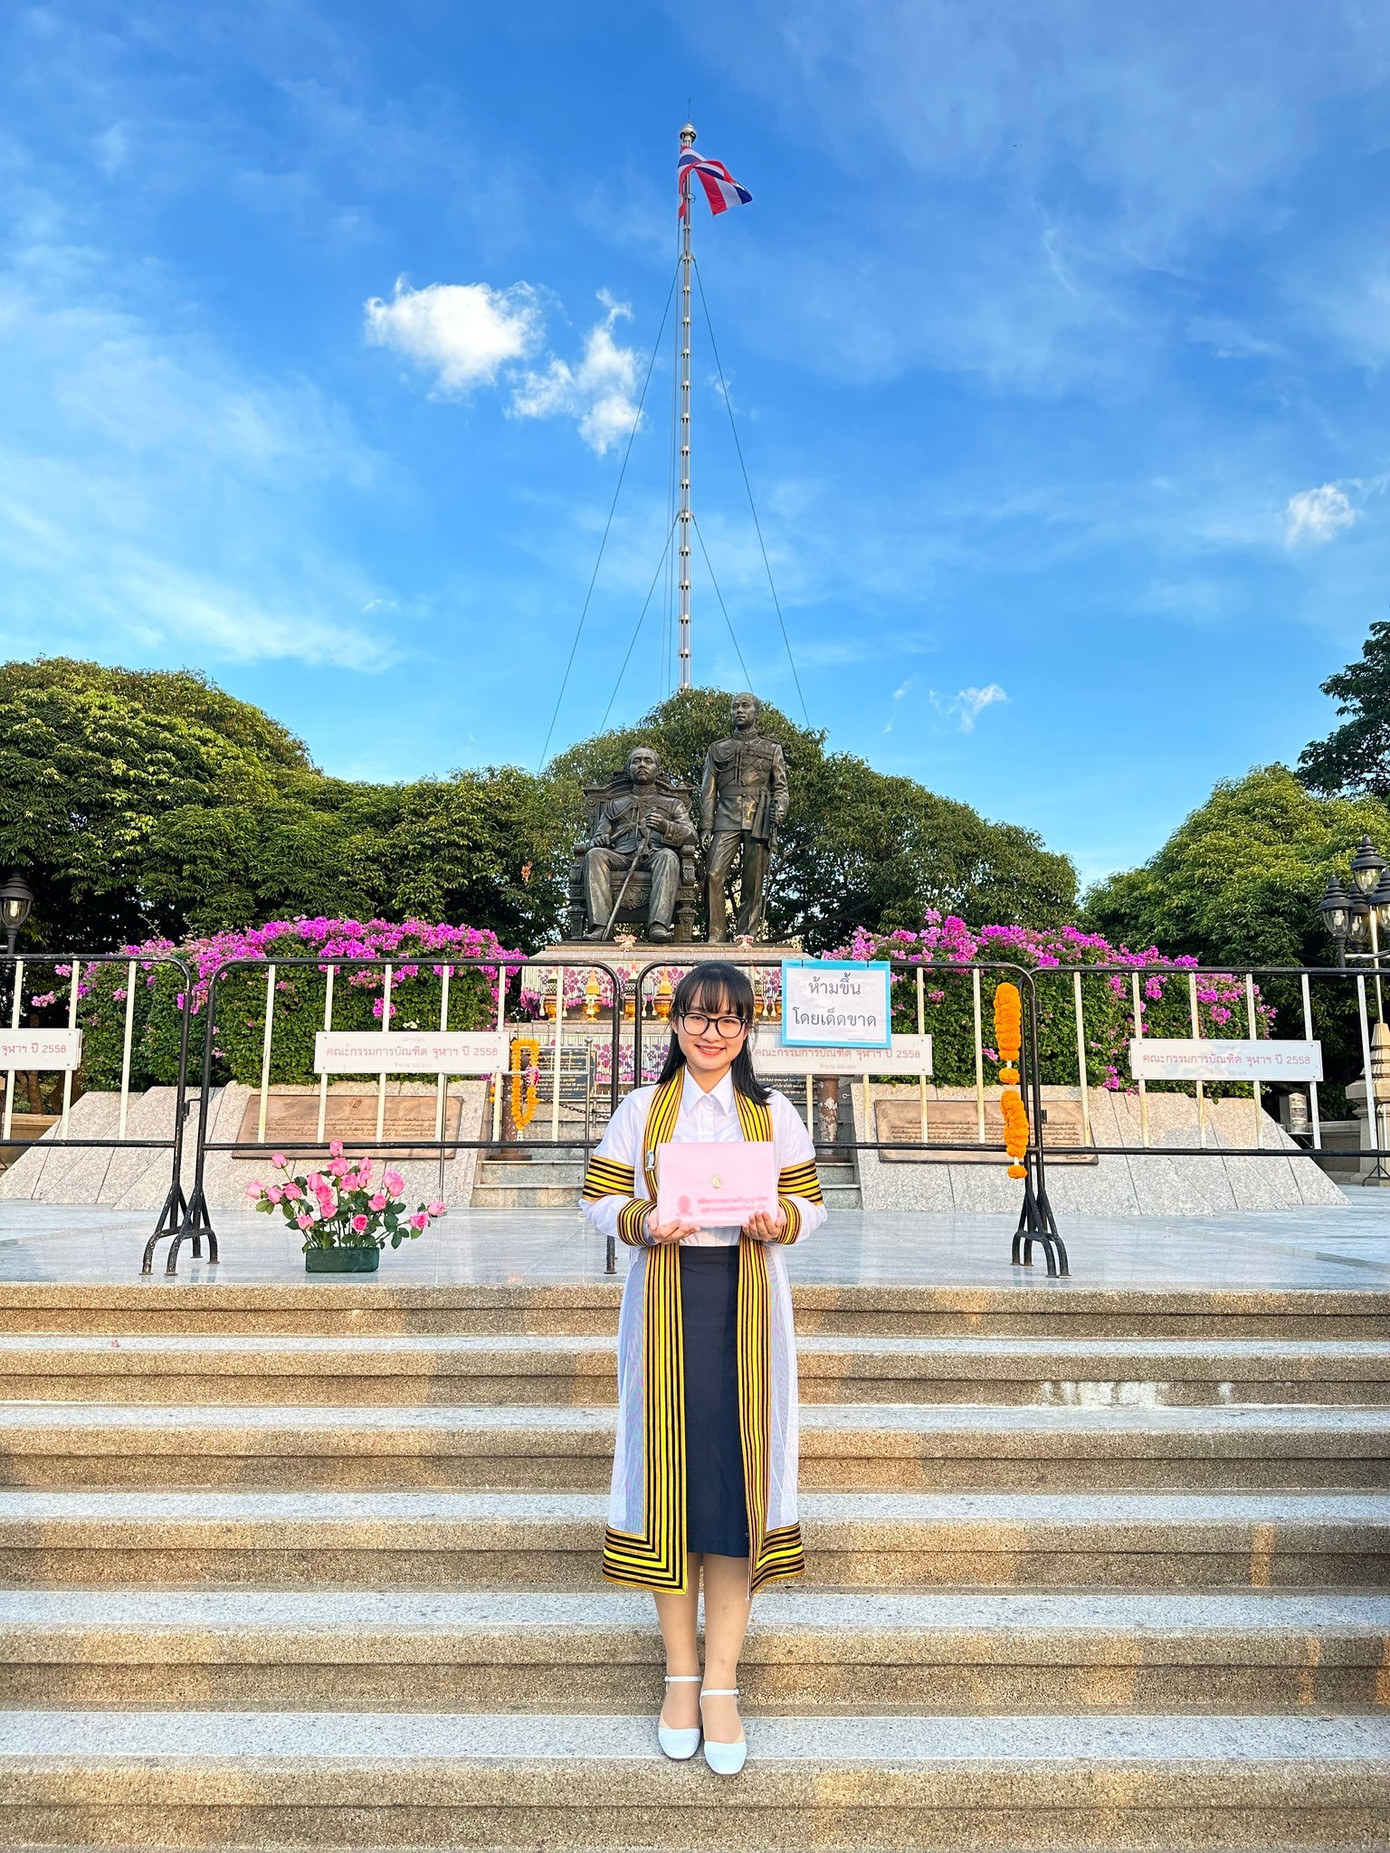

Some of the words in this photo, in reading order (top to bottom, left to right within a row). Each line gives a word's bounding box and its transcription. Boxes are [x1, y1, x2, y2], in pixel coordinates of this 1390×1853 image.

[808, 971, 861, 995] ห้ามขึ้น
[792, 1006, 877, 1027] โดยเด็ดขาด
[1, 1045, 27, 1056] จุฬาฯ
[31, 1042, 39, 1053] ปี
[42, 1045, 67, 1053] 2558
[326, 1045, 428, 1056] คณะกรรมการบัณฑิต
[431, 1046, 459, 1059] จุฬาฯ
[462, 1045, 470, 1056] ปี
[473, 1047, 498, 1056] 2558
[856, 1048, 882, 1061] จุฬาฯ
[896, 1050, 921, 1059] 2558
[1143, 1053, 1242, 1065] คณะกรรมการบัณฑิต
[1245, 1055, 1272, 1067] จุฬาฯ
[1275, 1053, 1283, 1065] ปี
[1286, 1056, 1311, 1065] 2558
